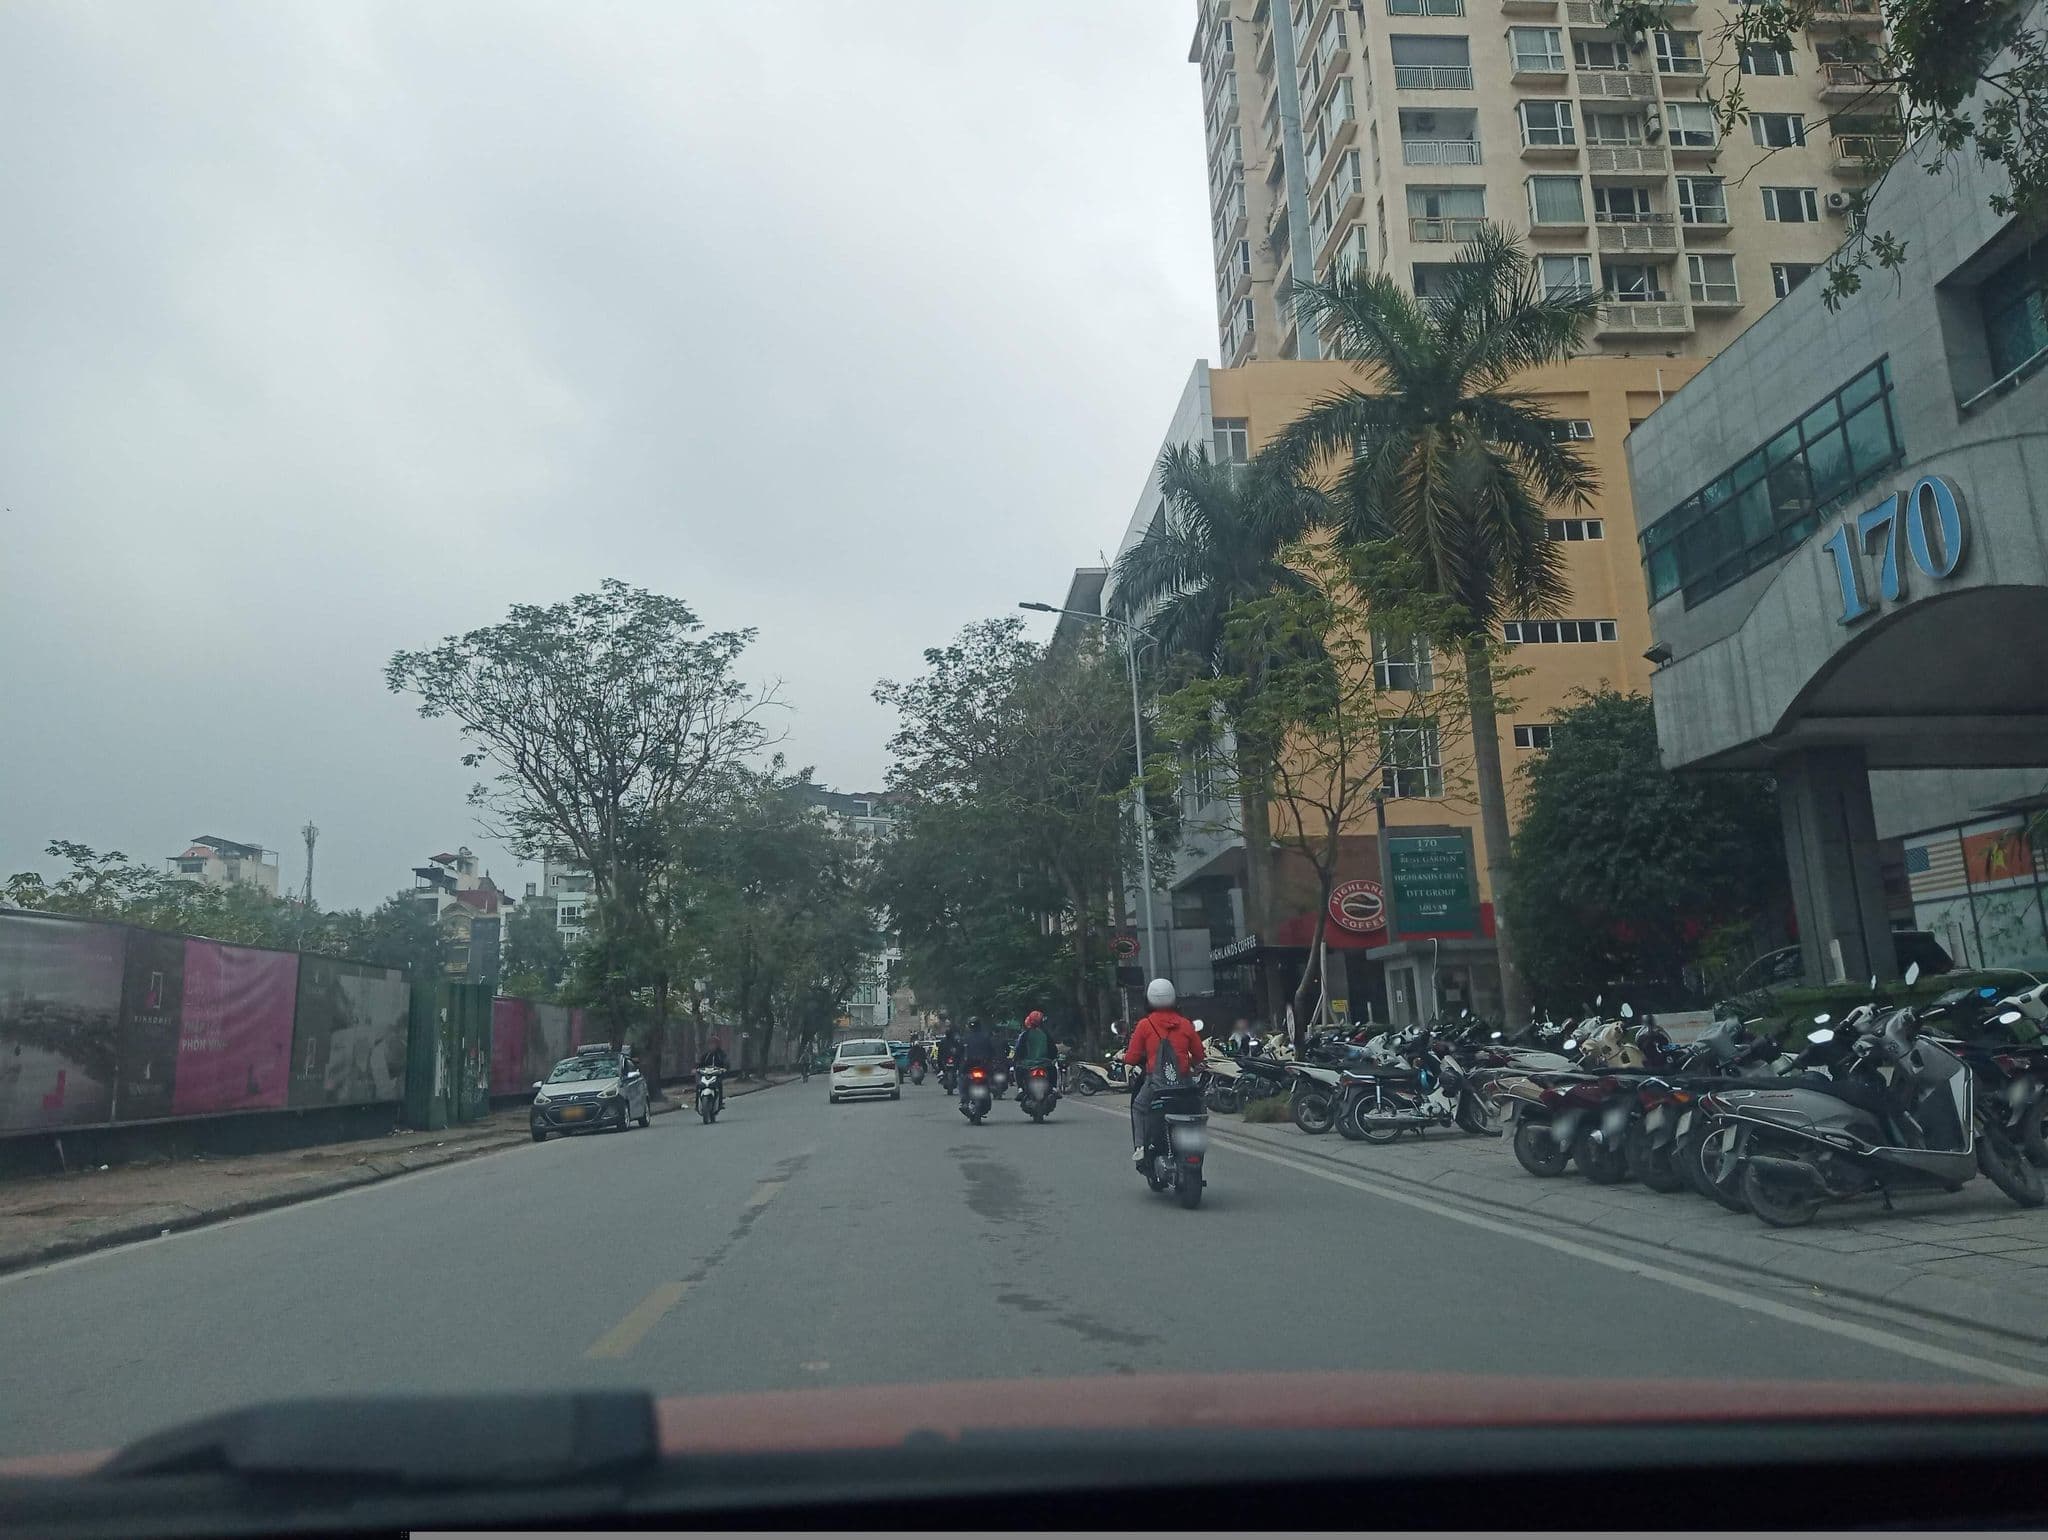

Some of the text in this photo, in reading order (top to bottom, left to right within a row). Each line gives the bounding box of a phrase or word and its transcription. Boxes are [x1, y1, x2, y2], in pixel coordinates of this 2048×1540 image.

[1823, 474, 1967, 626] 170
[1416, 839, 1438, 848] 170
[1342, 914, 1387, 929] COFFEE
[1238, 934, 1257, 953] COFFEE
